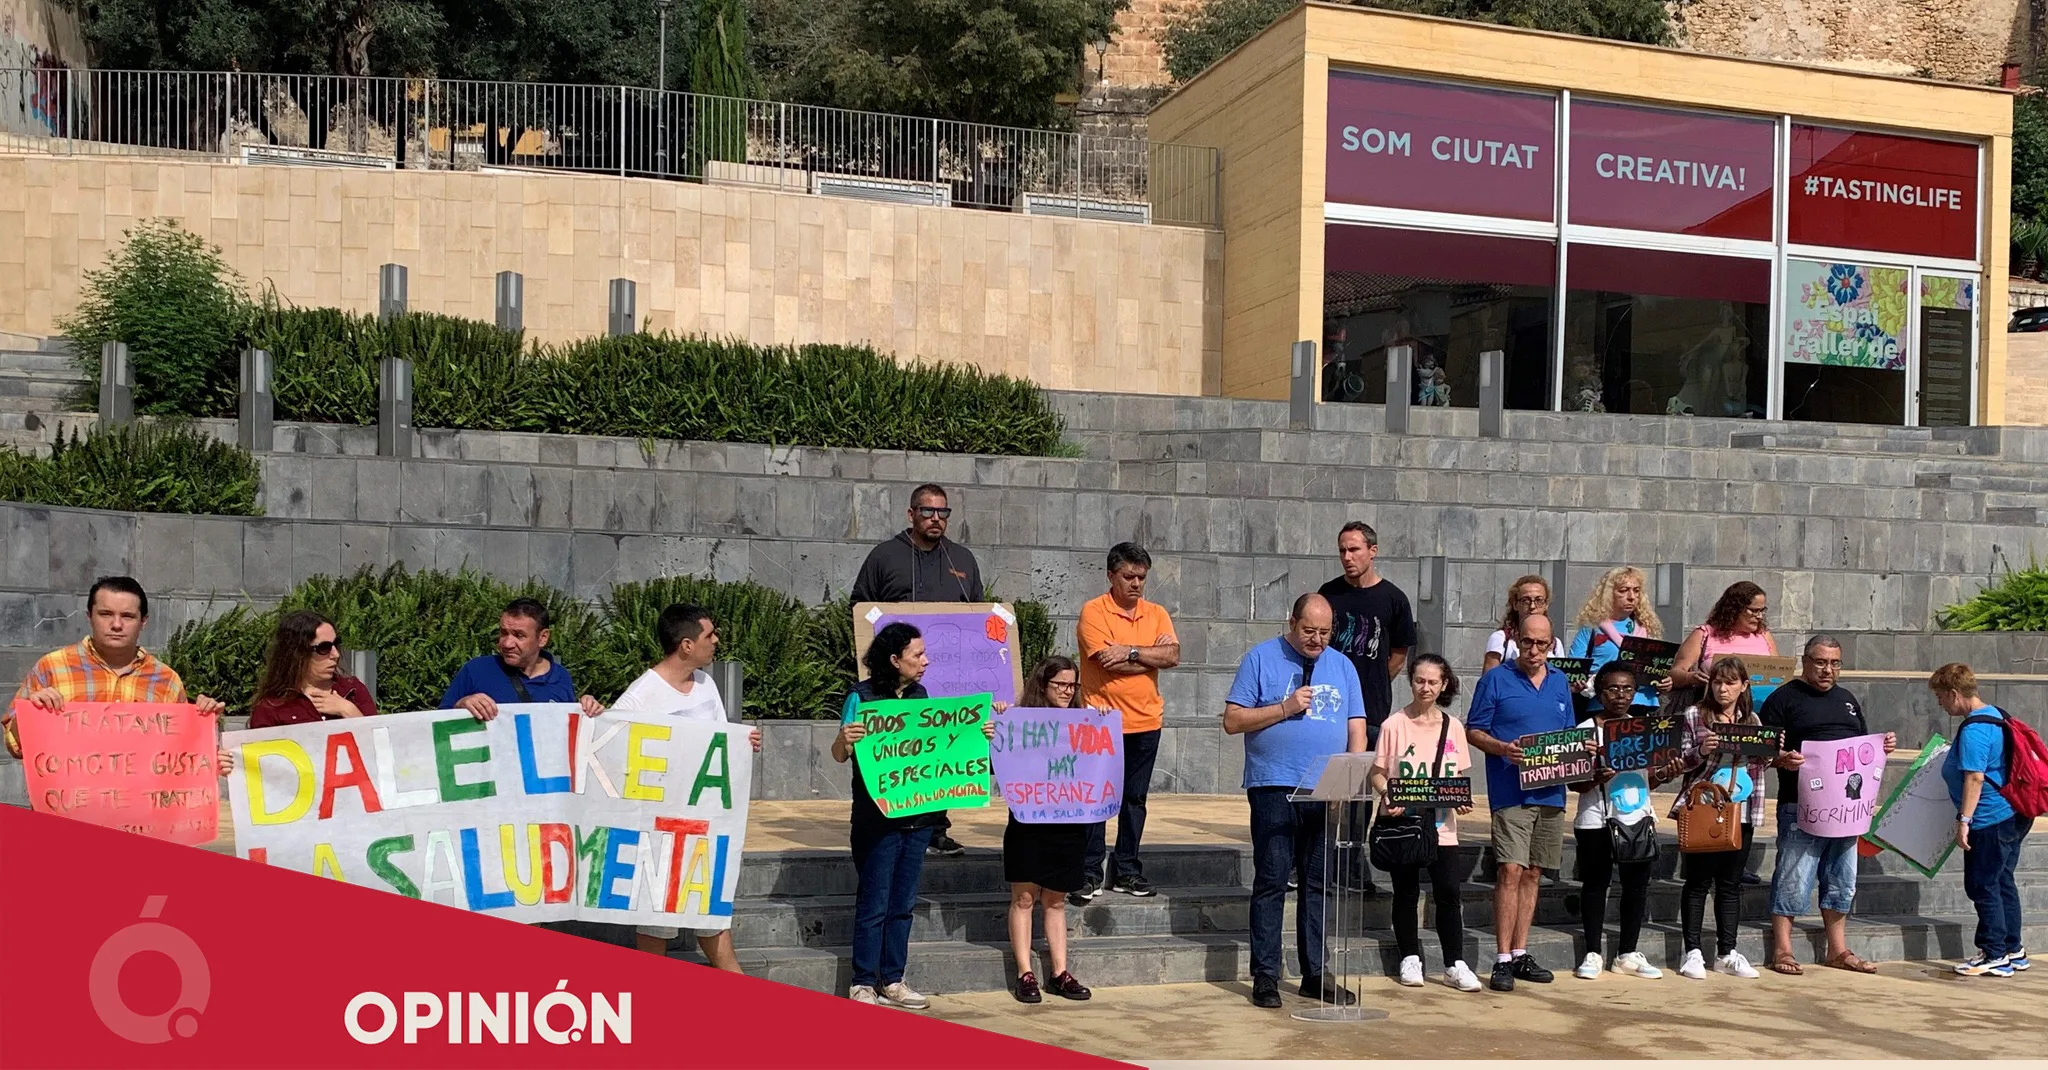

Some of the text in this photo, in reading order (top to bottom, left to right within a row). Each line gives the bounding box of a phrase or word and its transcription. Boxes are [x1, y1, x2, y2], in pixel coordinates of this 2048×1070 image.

[1342, 126, 1745, 191] SOM CIUTAT CREATIVA!
[1804, 174, 1962, 210] #TASTINGLIFE
[1815, 301, 1880, 329] Espai
[1793, 330, 1898, 360] Faller de
[62, 706, 181, 736] TRÁTAME
[857, 703, 984, 736] TODOS SOMOS
[1606, 718, 1645, 741] TUS
[946, 733, 960, 749] Y
[1022, 719, 1060, 750] HAY
[1067, 716, 1116, 756] VIDA
[1537, 729, 1590, 746] ENFERME
[1741, 735, 1764, 744] COSA
[152, 750, 212, 776] GUSTA
[1523, 745, 1543, 756] DAD
[1523, 754, 1560, 767] TIENE
[1610, 752, 1648, 770] CIOS
[1835, 742, 1875, 775] NO
[241, 713, 732, 826] DALE LIKE A
[878, 757, 989, 795] ESPECIALES
[1047, 753, 1078, 780] HAY
[1521, 758, 1592, 784] TRATAMIENTO
[45, 789, 89, 812] QUE
[99, 788, 131, 810] TE
[946, 783, 988, 798] MENTAL
[1392, 794, 1428, 802] CAMBIAR
[1439, 786, 1470, 795] PUEDES
[1052, 808, 1085, 818] SALUD
